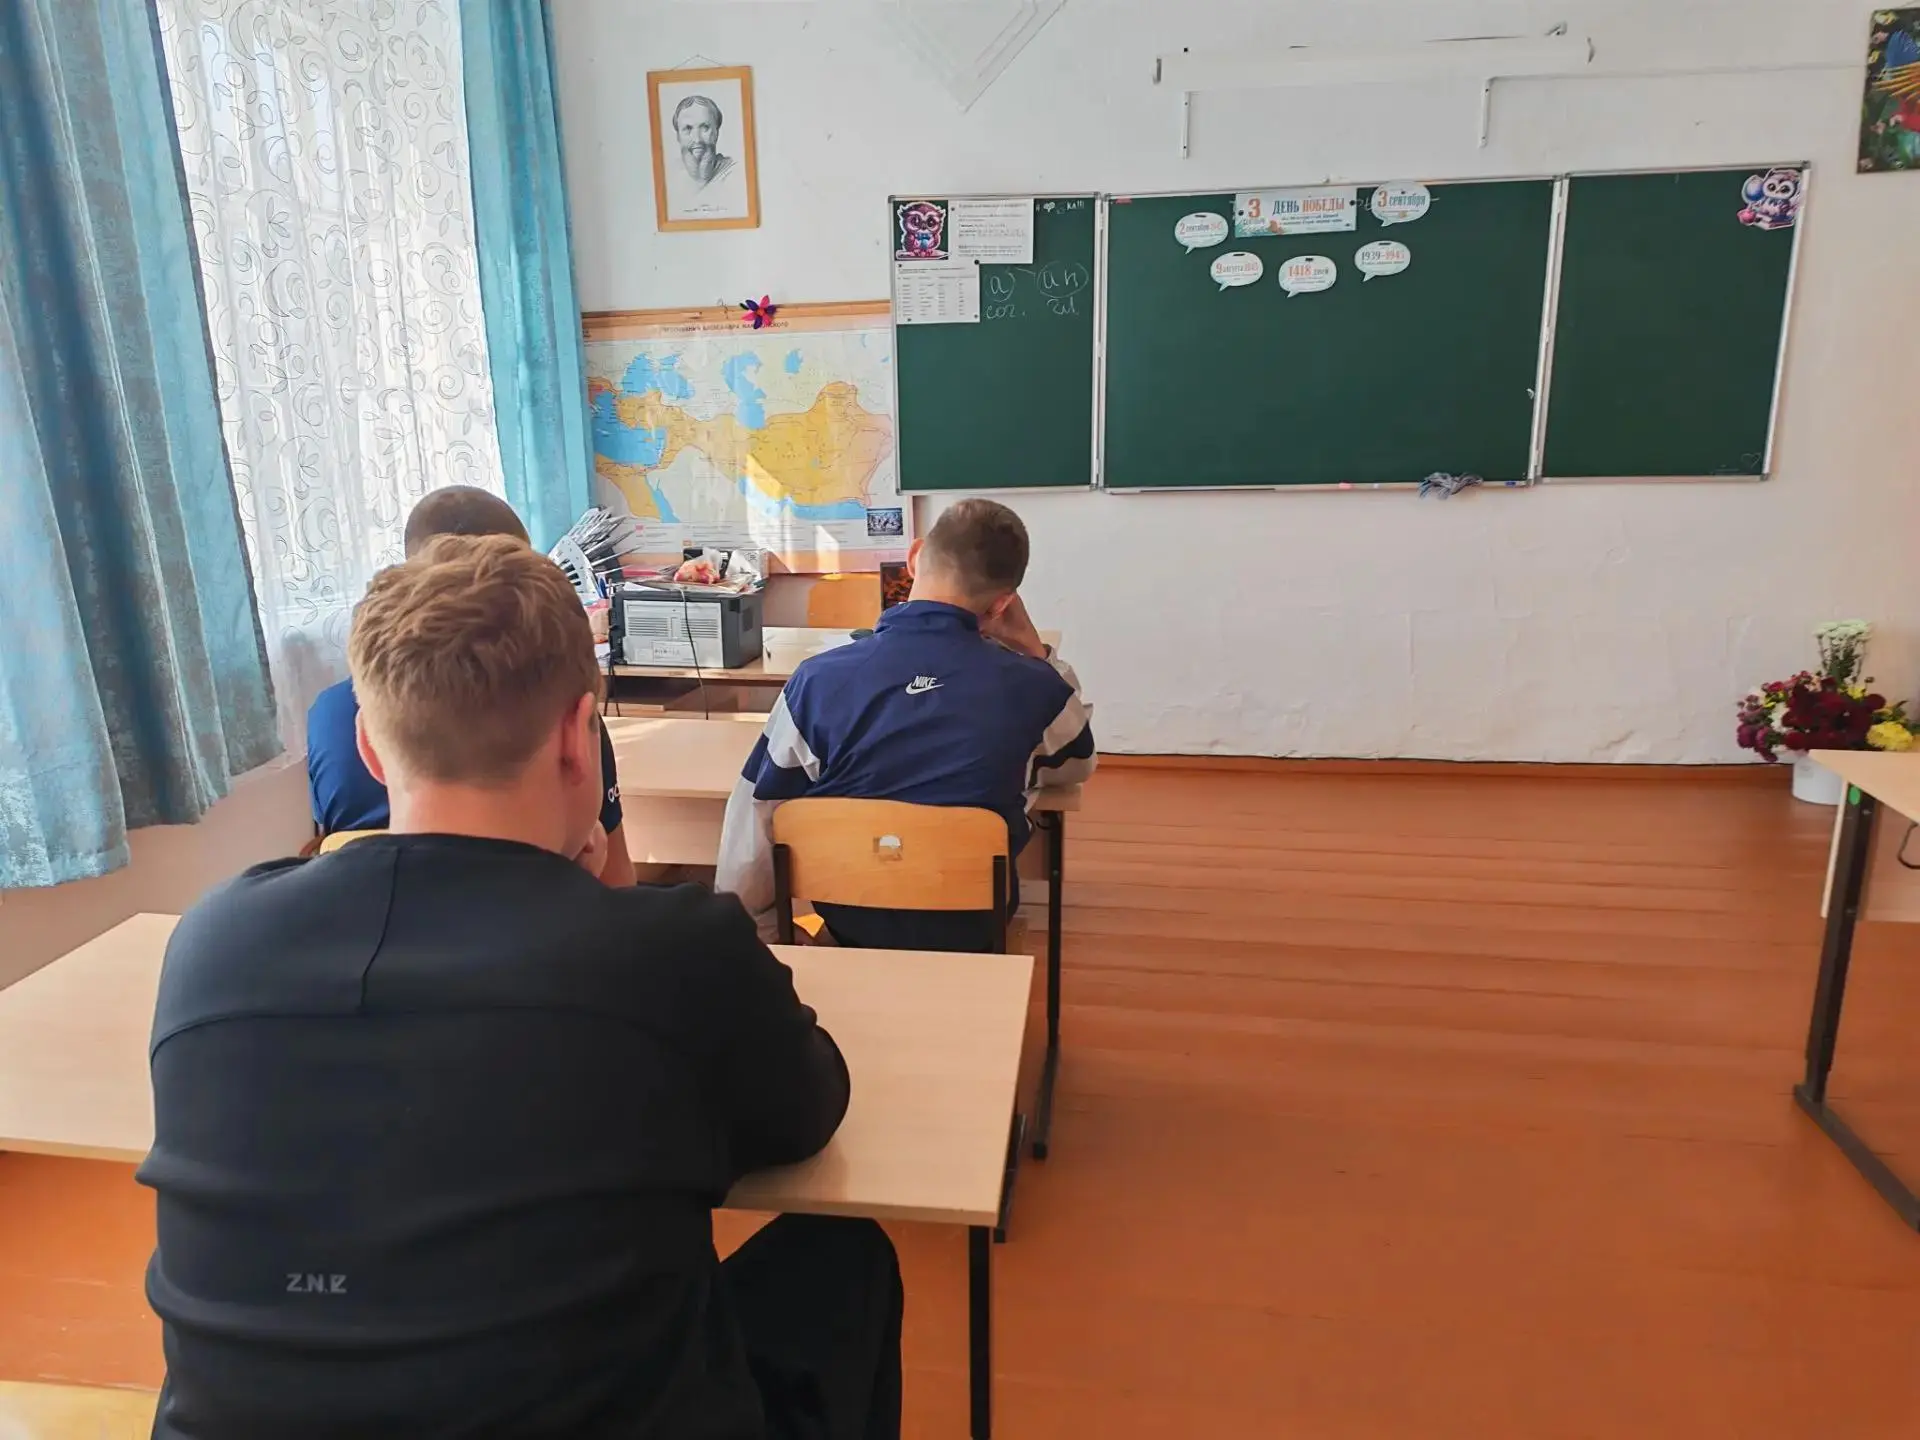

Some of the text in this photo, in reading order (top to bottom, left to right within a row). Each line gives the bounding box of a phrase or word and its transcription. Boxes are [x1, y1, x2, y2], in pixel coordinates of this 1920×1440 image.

[1378, 190, 1387, 207] 3
[1248, 198, 1260, 217] 3
[1272, 199, 1300, 216] ДЕНЬ
[1302, 197, 1345, 213] ПОБЕДЫ
[1179, 223, 1186, 235] 2
[1215, 262, 1222, 274] 9
[1287, 263, 1312, 277] 1418
[912, 675, 938, 688] NIKE
